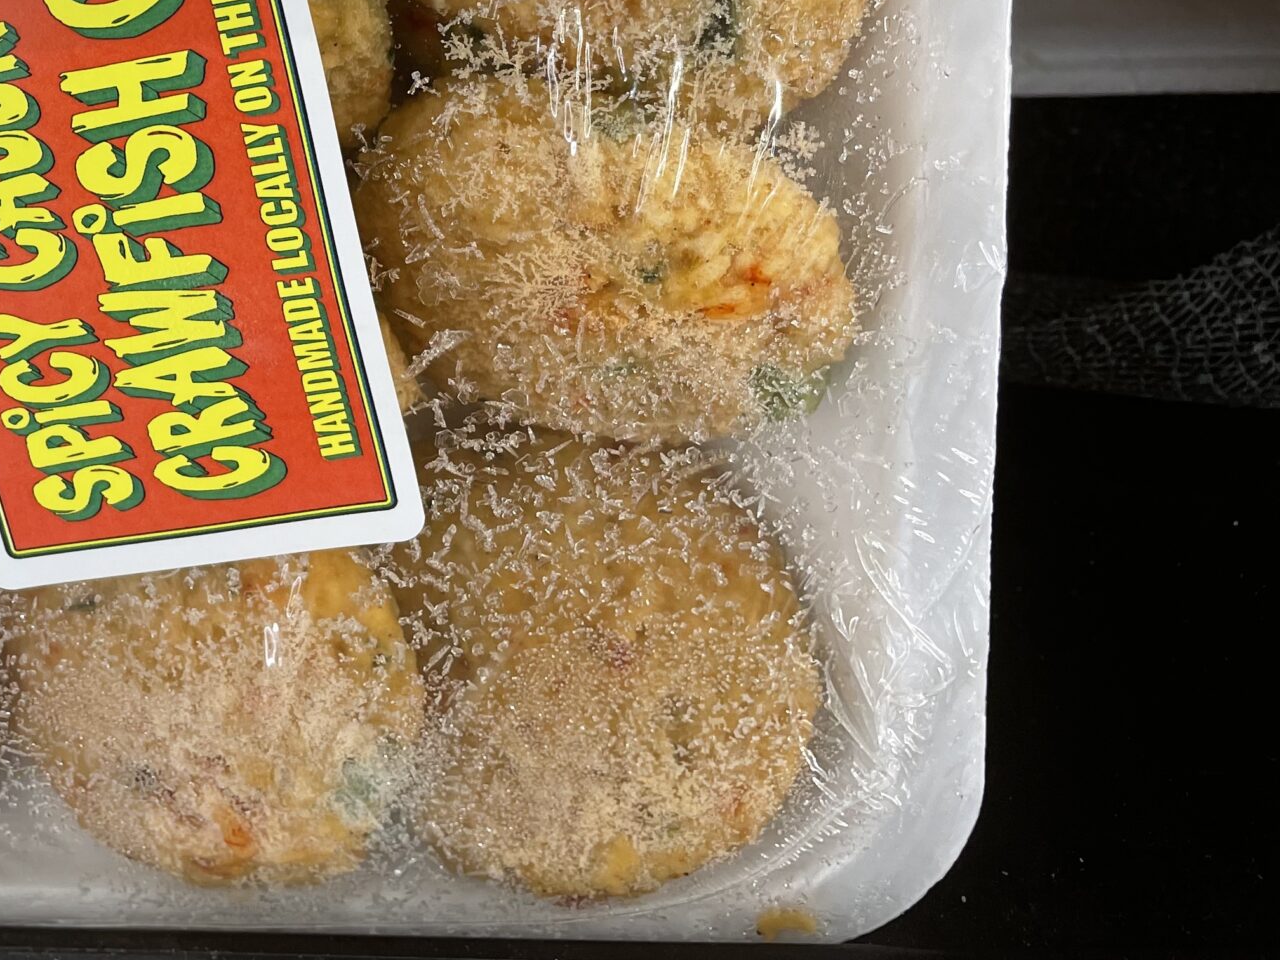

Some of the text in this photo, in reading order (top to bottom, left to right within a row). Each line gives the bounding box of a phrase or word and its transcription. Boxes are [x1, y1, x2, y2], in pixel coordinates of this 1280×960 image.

[222, 60, 280, 115] ON
[242, 123, 312, 274] LOCALLY
[277, 276, 363, 460] HANDMADE
